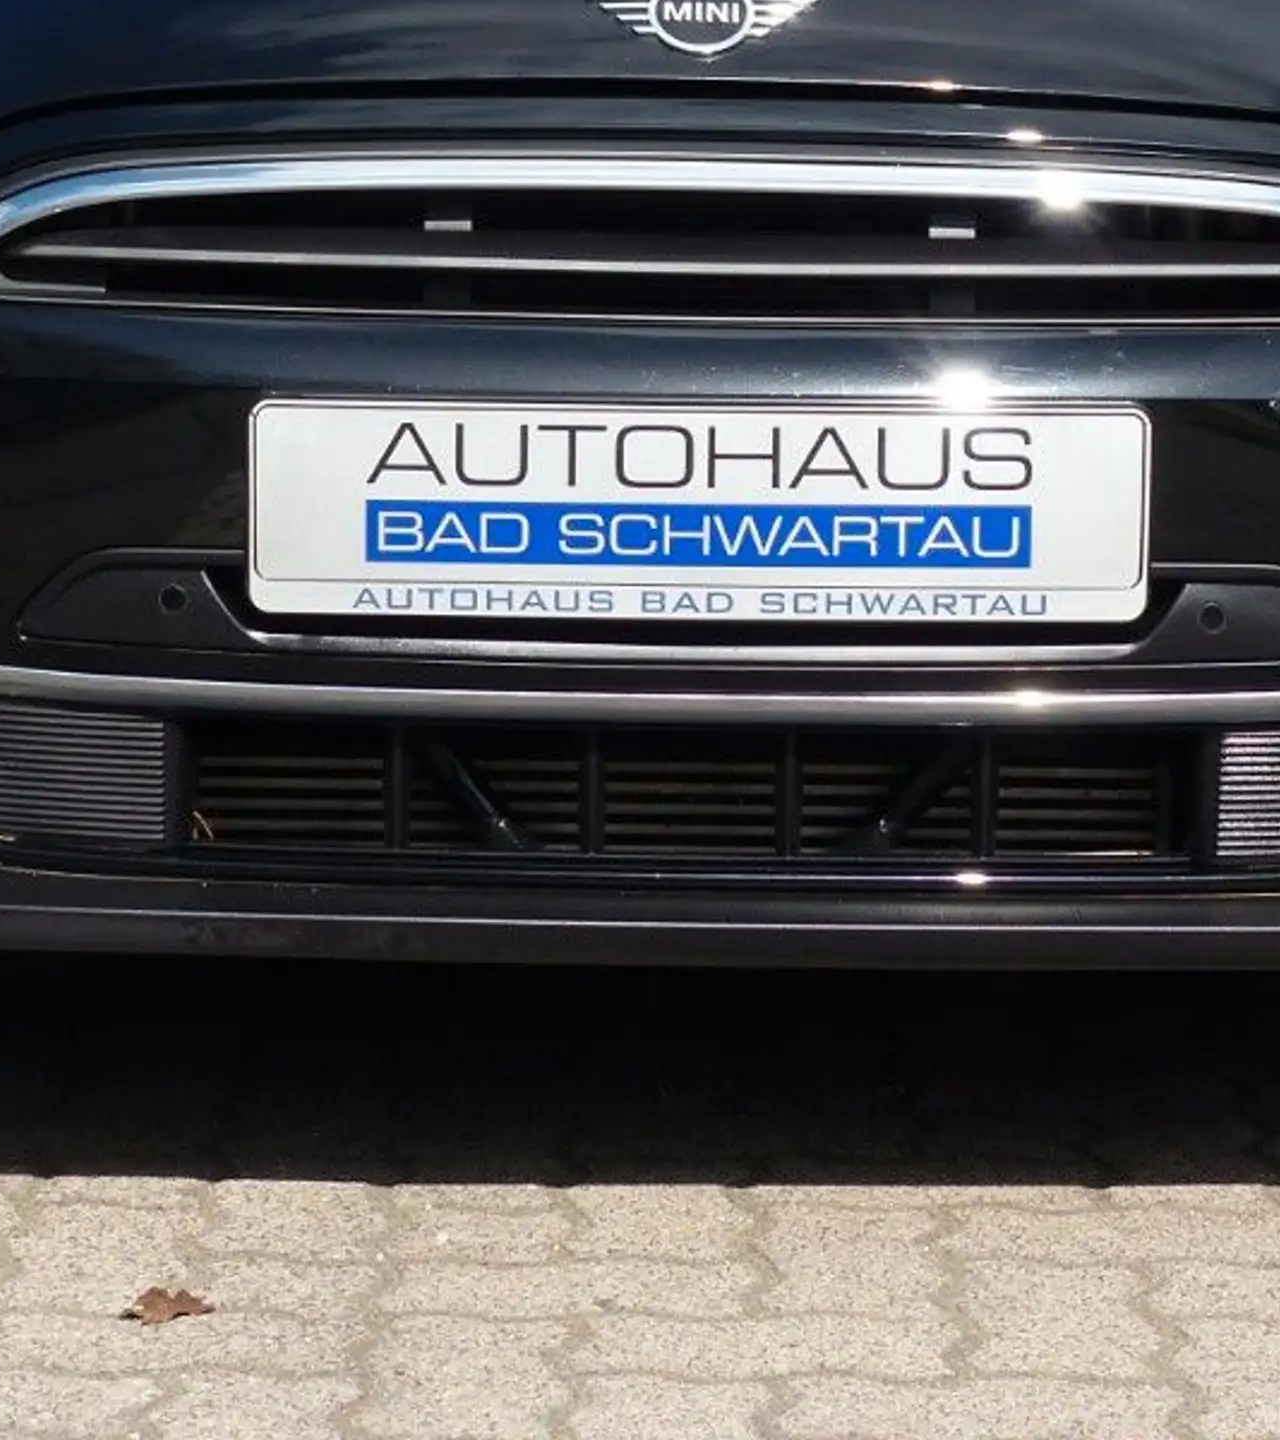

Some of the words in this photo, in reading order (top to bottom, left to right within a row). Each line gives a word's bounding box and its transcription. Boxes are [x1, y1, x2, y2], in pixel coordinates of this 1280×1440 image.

[663, 0, 740, 25] MINI
[366, 421, 1035, 492] AUTOHAUS
[376, 509, 530, 557] BAD
[558, 511, 1021, 560] SCHWARTAU
[352, 586, 615, 615] AUTOHAUS
[641, 589, 735, 616] BAD
[759, 591, 1049, 620] SCHWARTAU
